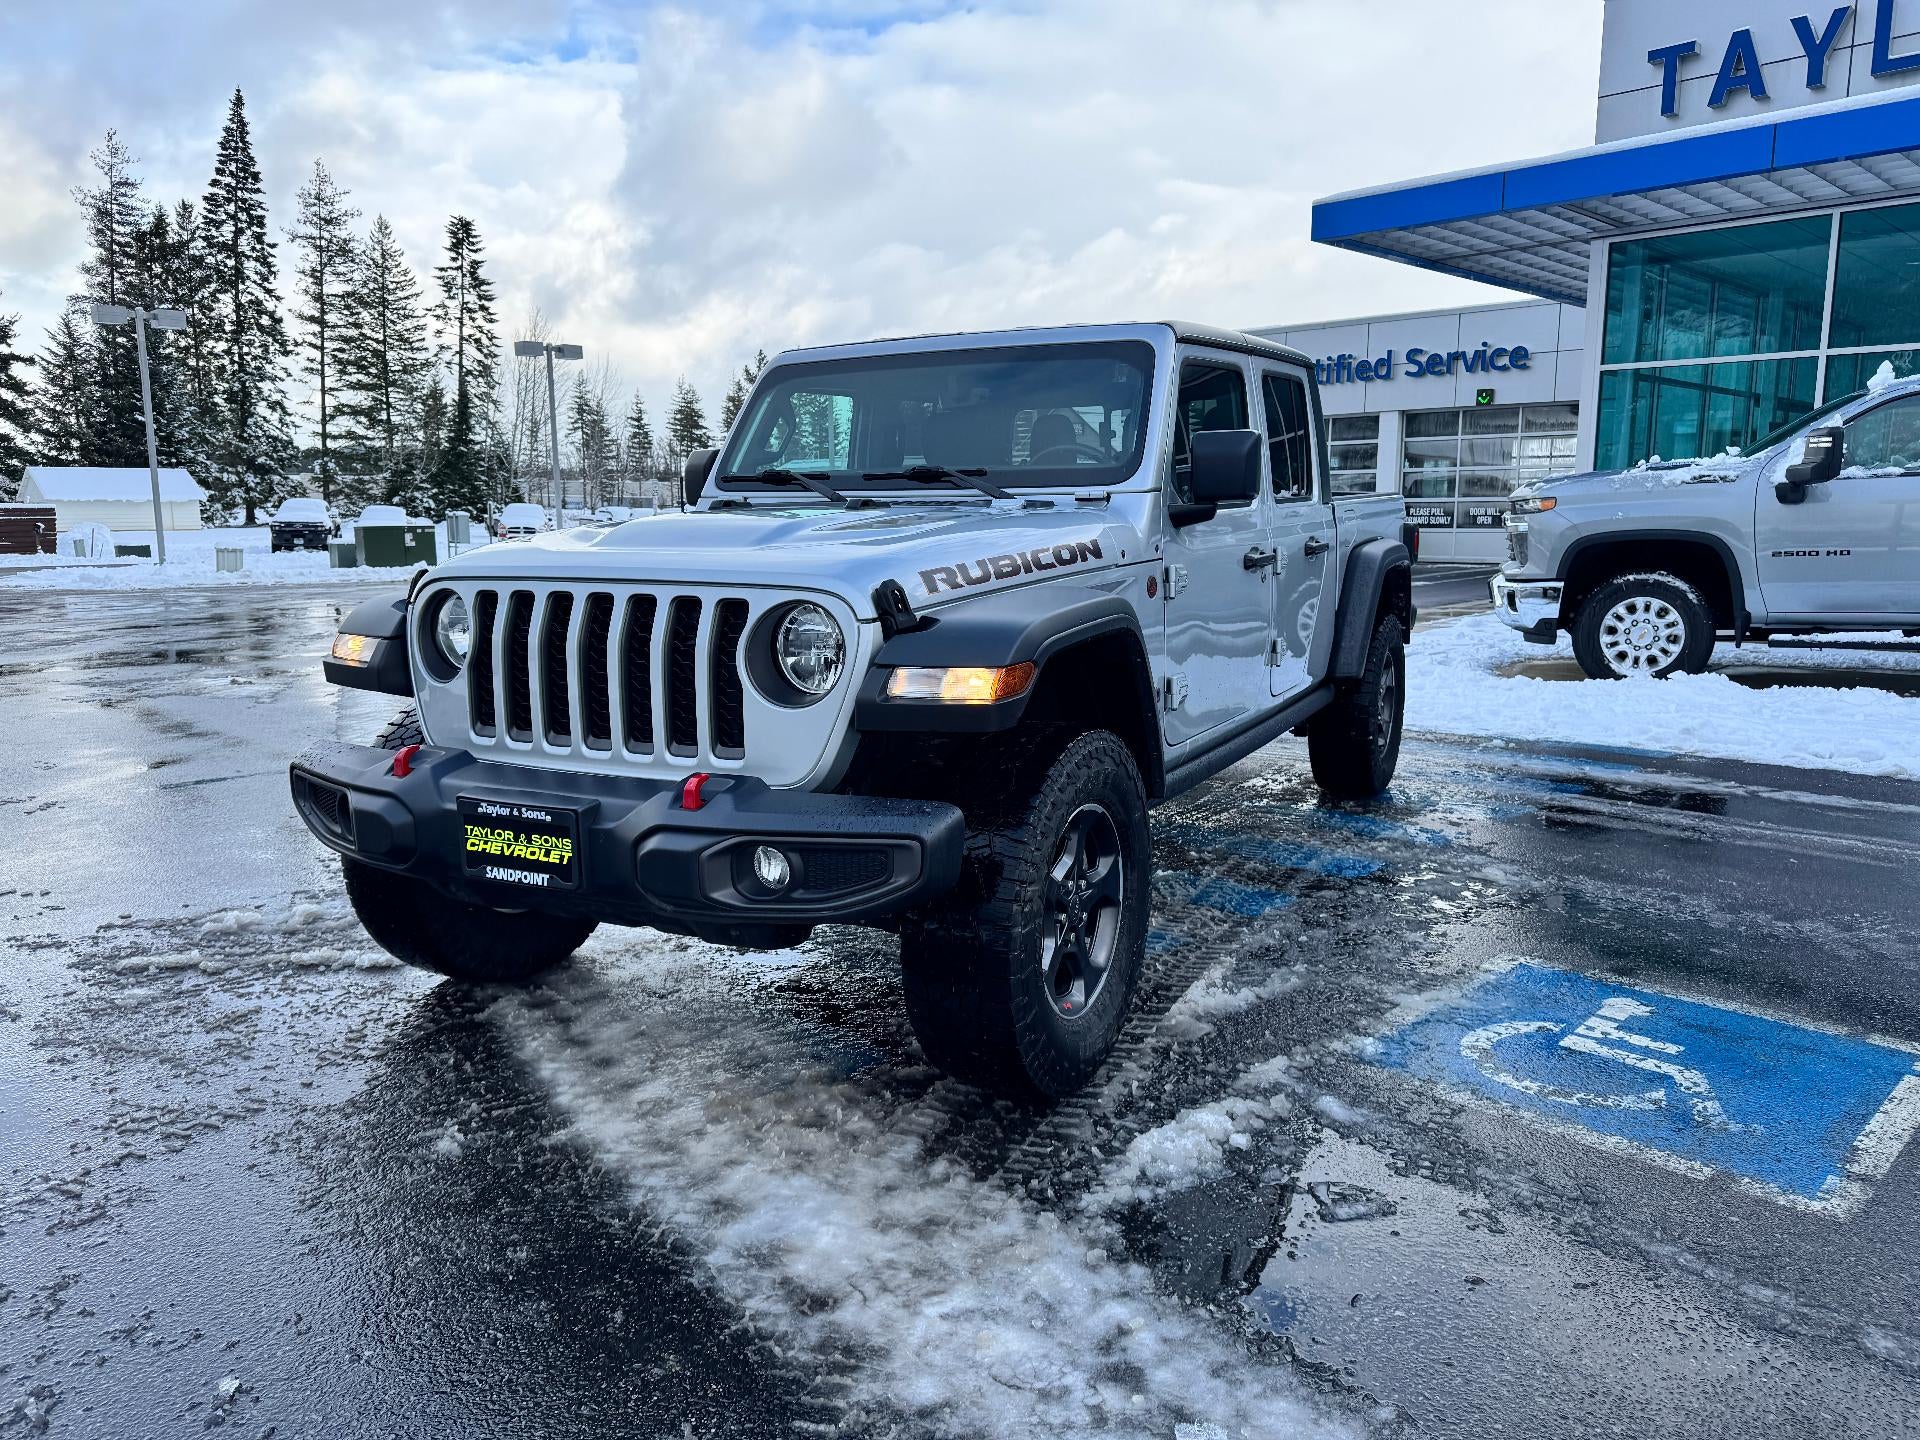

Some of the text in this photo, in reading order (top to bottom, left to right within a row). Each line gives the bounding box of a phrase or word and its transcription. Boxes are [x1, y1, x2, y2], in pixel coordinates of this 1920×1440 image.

[1404, 341, 1531, 377] Service
[1409, 507, 1444, 516] PLEASE PULL
[1429, 516, 1451, 525] SLOWLY
[1469, 507, 1501, 516] DOOR WILL
[1476, 515, 1492, 525] OPEN
[918, 538, 1104, 596] RUBICON
[480, 802, 546, 820] Taylor & Sons
[464, 825, 572, 850] TAYLOR & SONS
[466, 838, 573, 865] CHEVROLET
[485, 865, 550, 887] SANDPOINT
